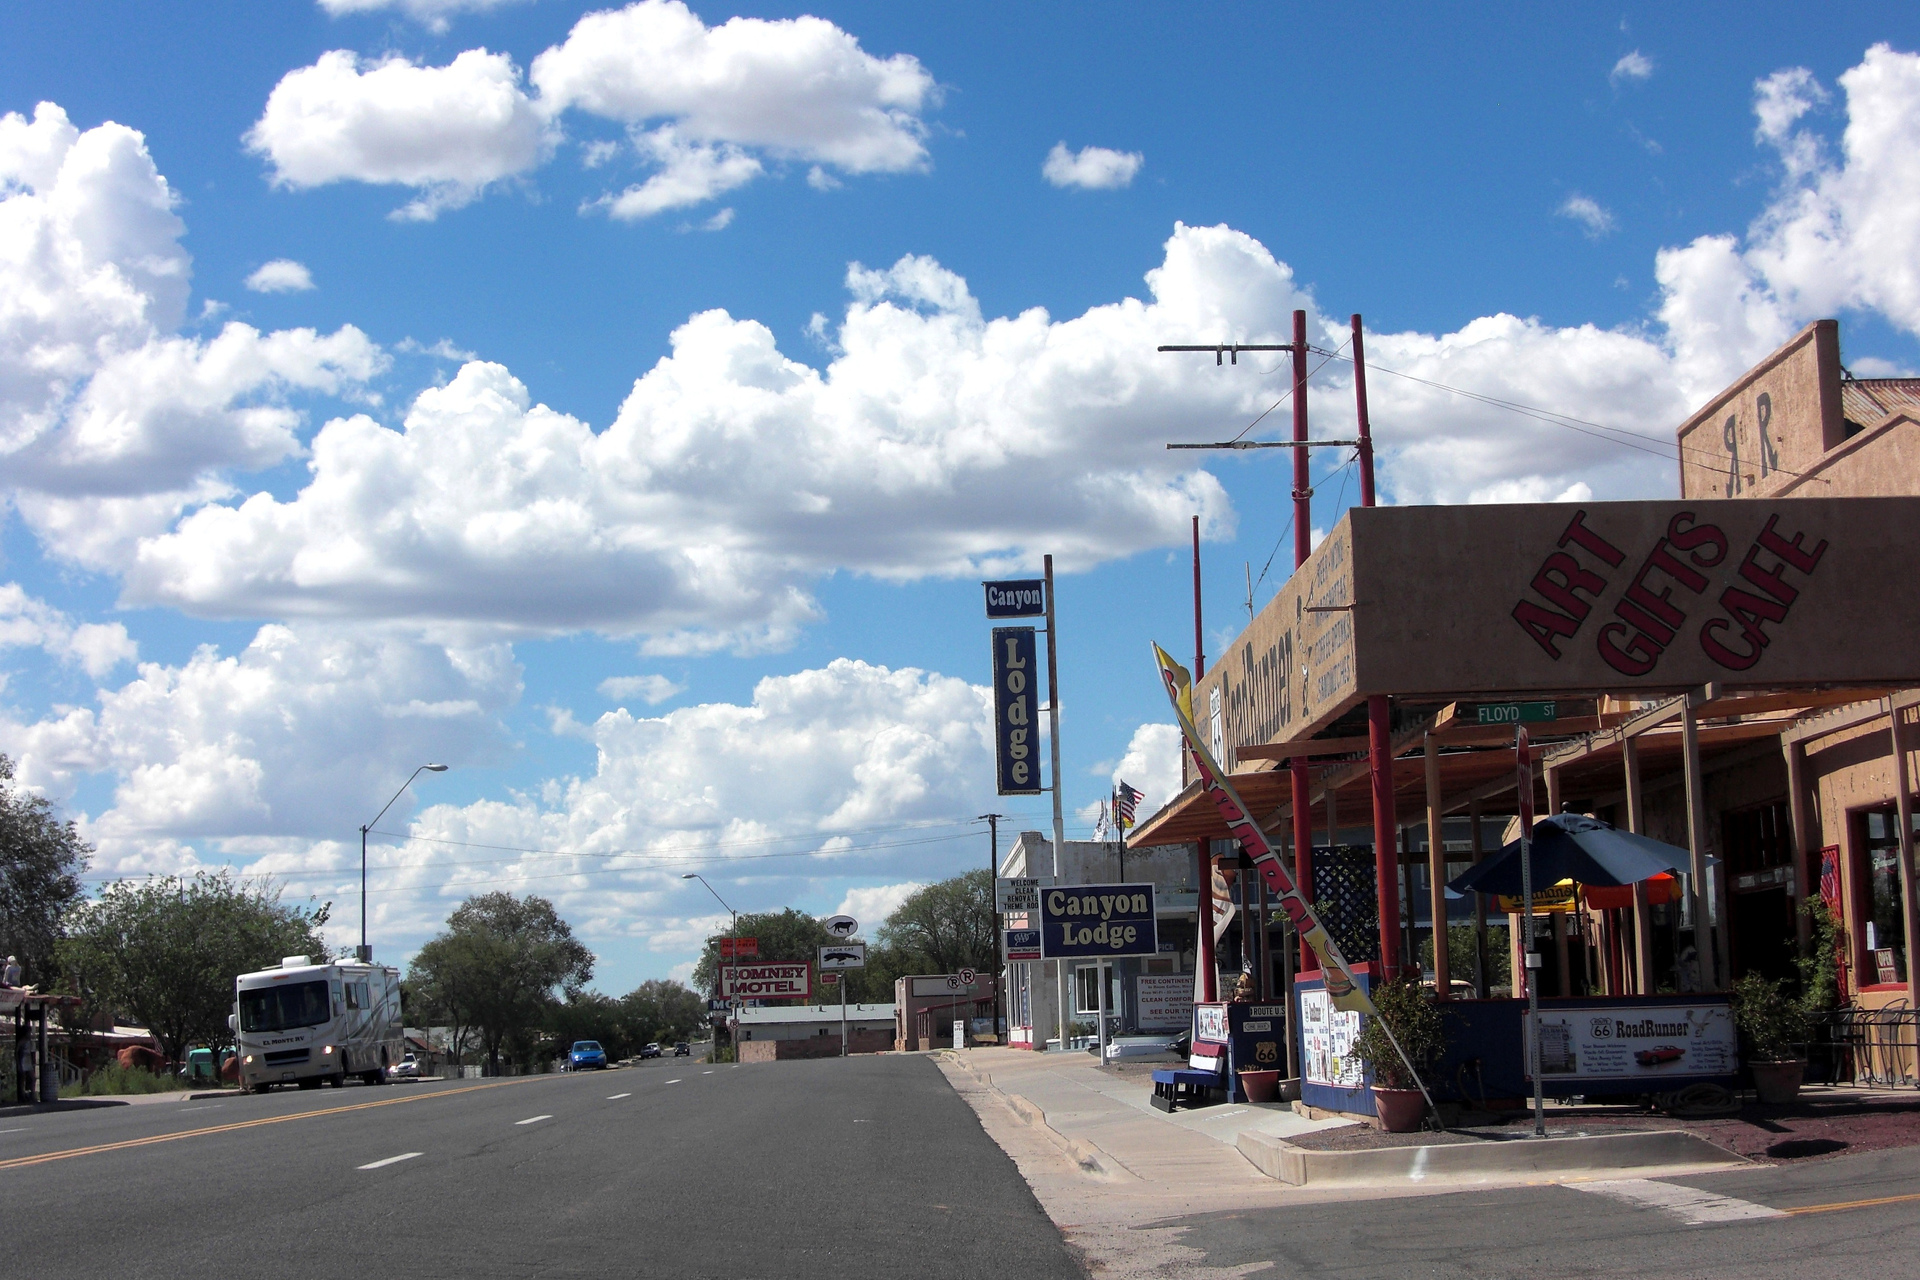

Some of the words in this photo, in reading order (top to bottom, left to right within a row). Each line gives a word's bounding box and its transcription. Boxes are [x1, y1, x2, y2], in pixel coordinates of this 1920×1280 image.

[1511, 510, 1626, 661] ART
[1698, 513, 1829, 672] CAFE
[987, 585, 1041, 610] Canyon
[1596, 511, 1729, 677] GIFTS
[1223, 627, 1293, 774] RoadRunner
[1005, 637, 1029, 785] Lodge
[1478, 706, 1520, 722] FLOYD
[1543, 704, 1555, 716] ST
[1010, 879, 1039, 887] WELCOME
[1015, 887, 1034, 895] CLEAN
[1003, 902, 1025, 910] THEME
[1007, 894, 1039, 902] RENOVATE
[1047, 890, 1148, 920] Canyon
[1062, 921, 1137, 949] Lodge
[1877, 951, 1893, 967] OPEN
[725, 967, 806, 980] ROMNEY
[729, 980, 802, 994] MOTEL
[1254, 1006, 1273, 1016] ROUTE
[1593, 1025, 1610, 1036] 66
[1616, 1019, 1689, 1039] RoadRunner
[271, 1037, 294, 1045] MONTE
[1258, 1049, 1275, 1061] 66
